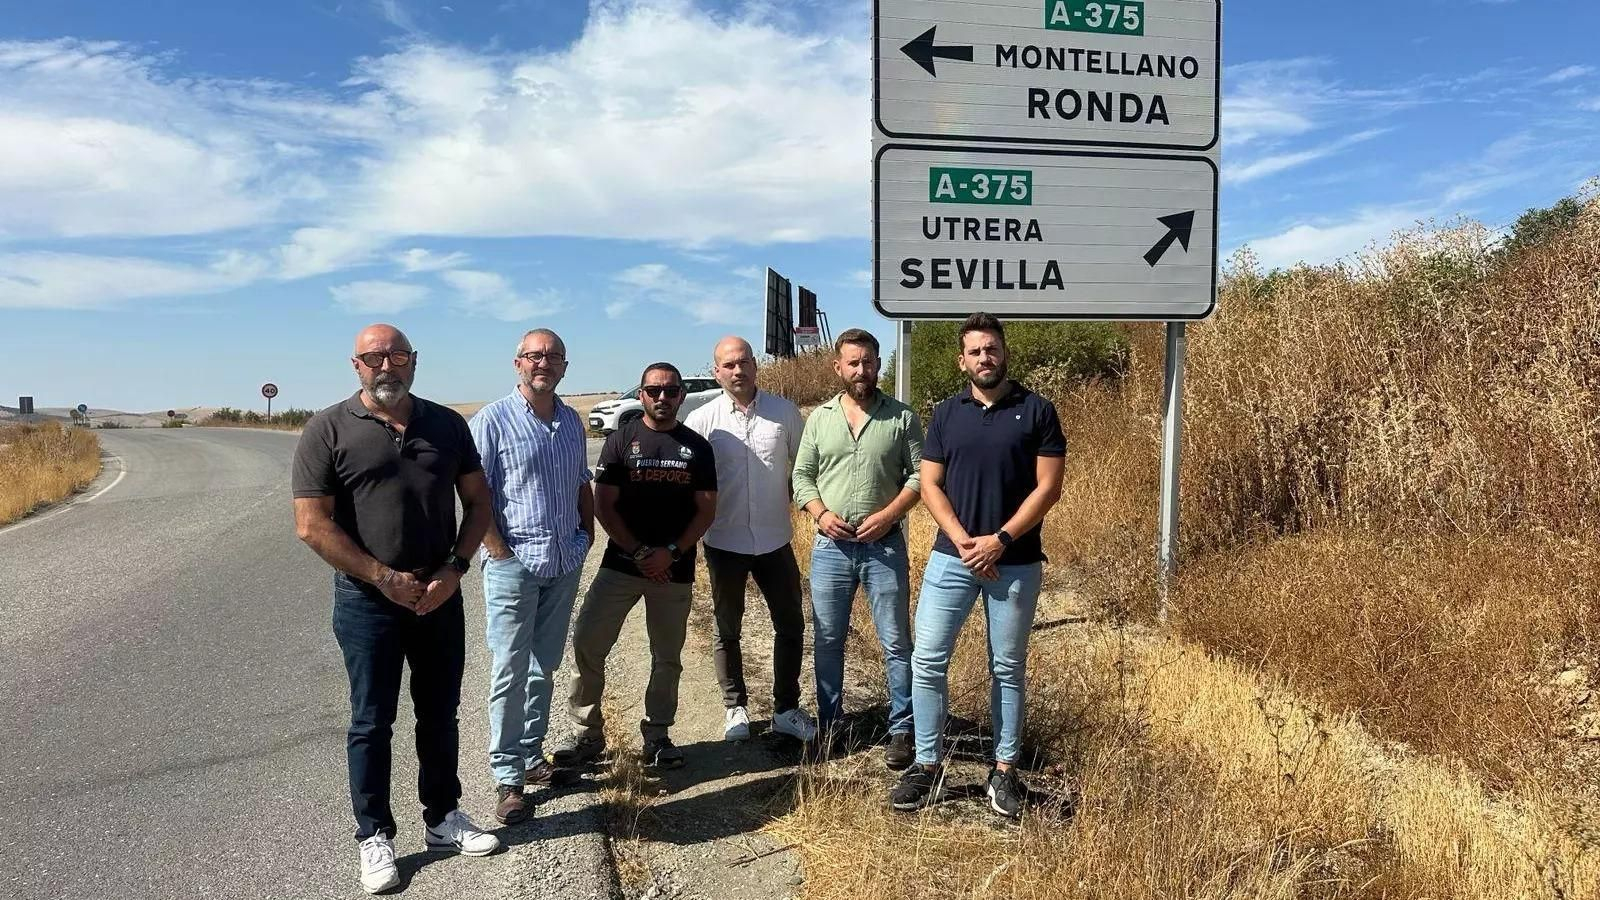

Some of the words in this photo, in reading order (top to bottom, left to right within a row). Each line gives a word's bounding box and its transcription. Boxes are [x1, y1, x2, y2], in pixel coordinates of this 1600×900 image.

[1050, 1, 1140, 29] A-375
[996, 44, 1198, 79] MONTELLANO
[1029, 88, 1169, 125] RONDA
[935, 174, 1027, 200] A-375
[923, 216, 1043, 241] UTRERA
[900, 258, 1064, 290] SEVILLA
[632, 470, 642, 481] ES
[646, 469, 692, 483] DEPORTE
[636, 459, 659, 467] PUERTO
[660, 460, 687, 469] SERRANO
